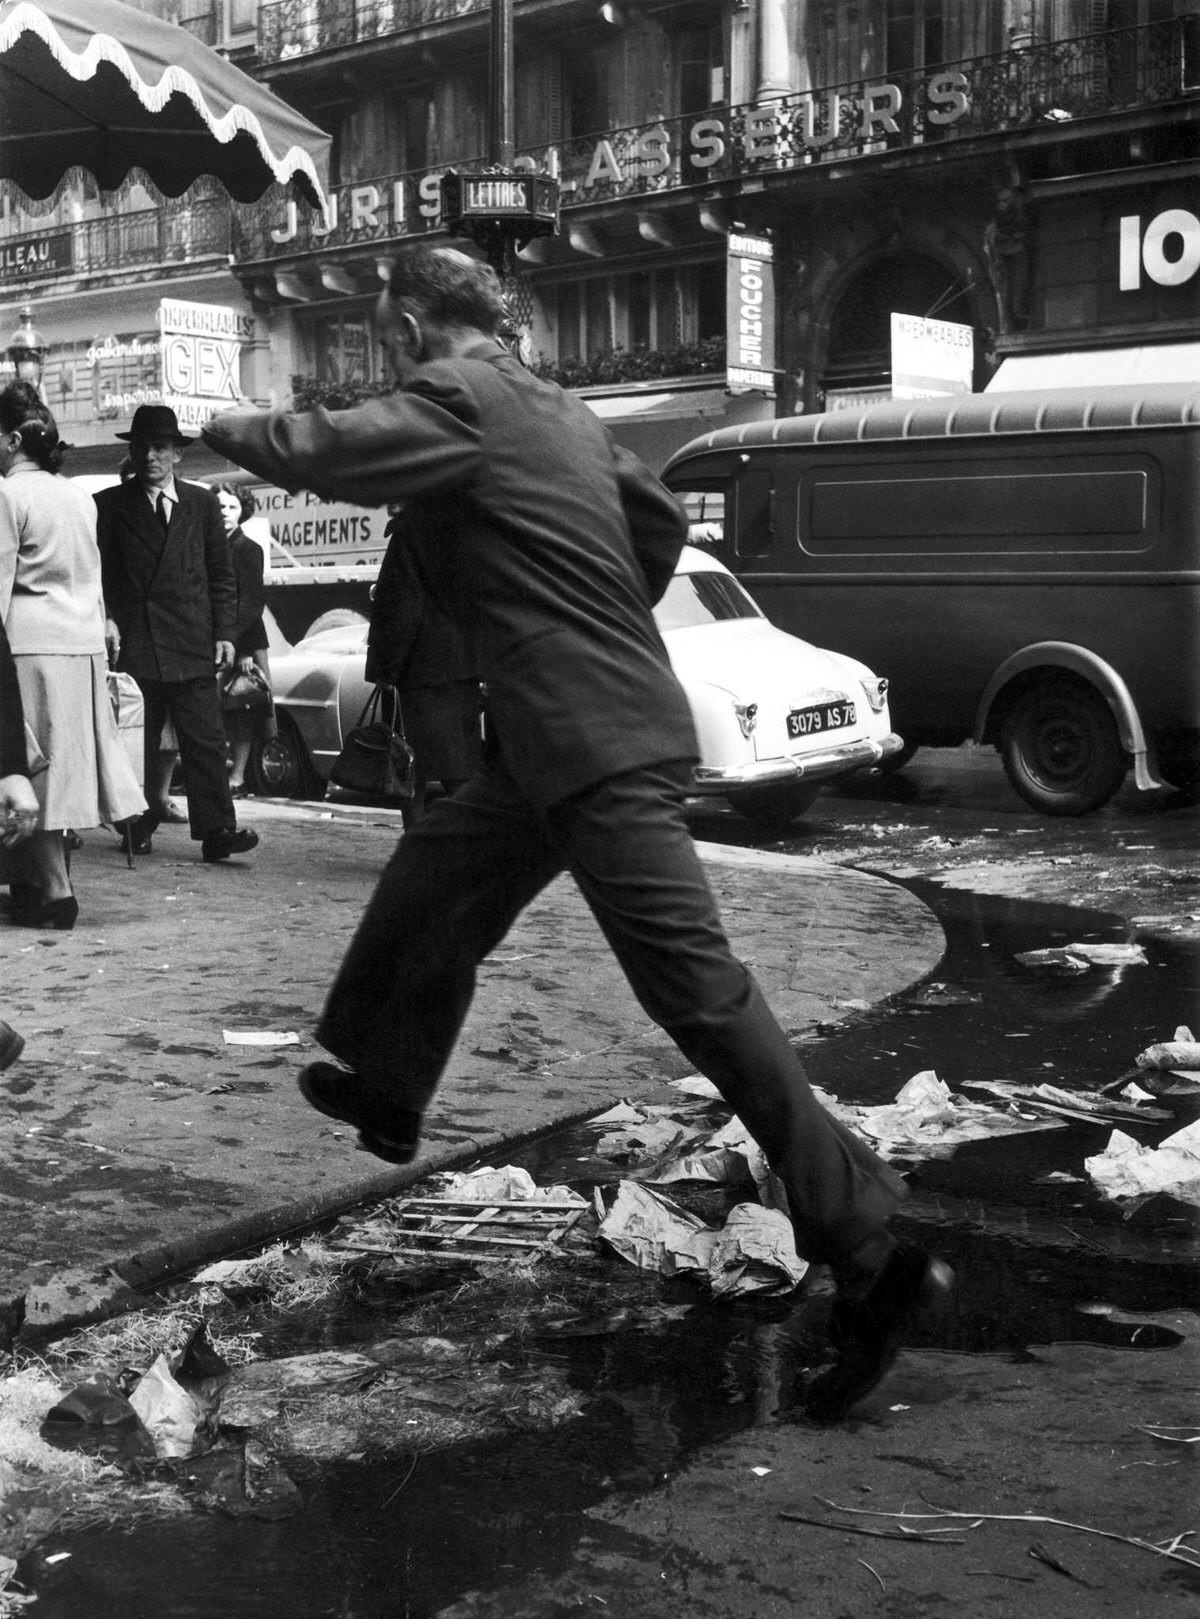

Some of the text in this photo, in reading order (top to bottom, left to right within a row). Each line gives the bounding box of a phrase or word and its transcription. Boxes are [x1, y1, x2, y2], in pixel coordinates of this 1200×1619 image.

[271, 175, 443, 243] JURIS
[469, 181, 527, 208] LETTRES
[739, 257, 764, 366] FOUCHER
[164, 338, 243, 400] GEX
[789, 704, 857, 734] 3079 AS 78
